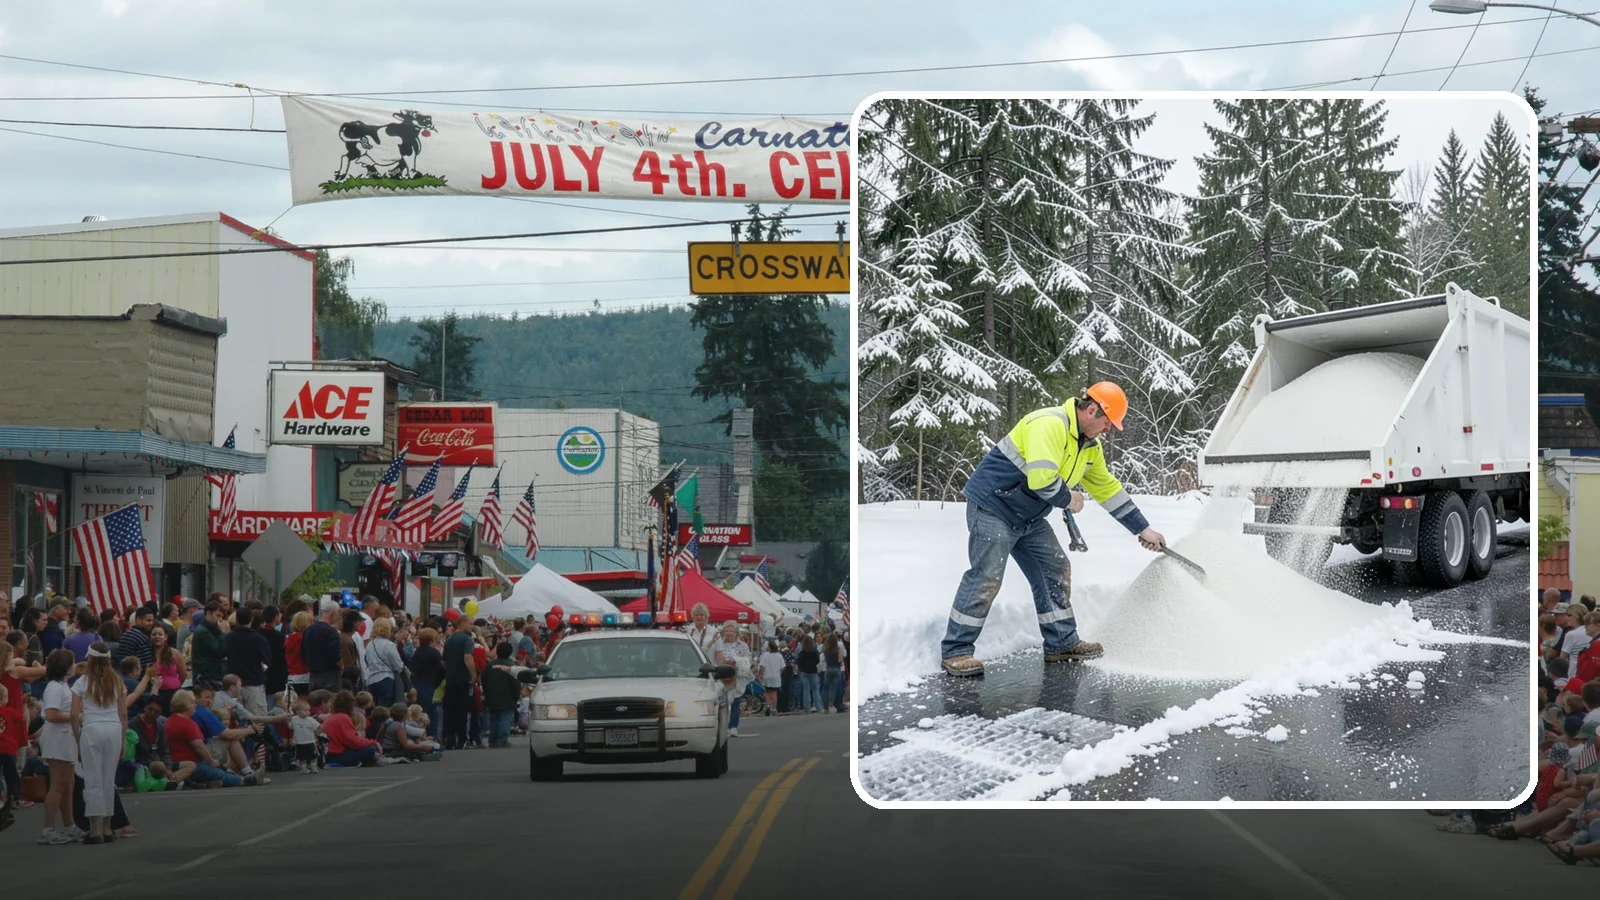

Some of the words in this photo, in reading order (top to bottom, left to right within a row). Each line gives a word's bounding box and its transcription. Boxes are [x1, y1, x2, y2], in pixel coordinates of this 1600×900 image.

[694, 121, 850, 150] Carnat
[481, 140, 604, 192] JULY
[632, 149, 746, 198] 4th.
[696, 254, 850, 280] CROSSWA
[282, 380, 373, 420] ACE
[406, 409, 452, 421] CEDAR
[283, 421, 371, 436] Hardware
[416, 428, 477, 447] Coca-Cola
[353, 467, 386, 480] Simpl
[95, 485, 124, 495] Vincent
[126, 485, 136, 495] de
[138, 486, 155, 495] Paul
[688, 526, 741, 535] CRNATION
[699, 535, 730, 543] GLASS
